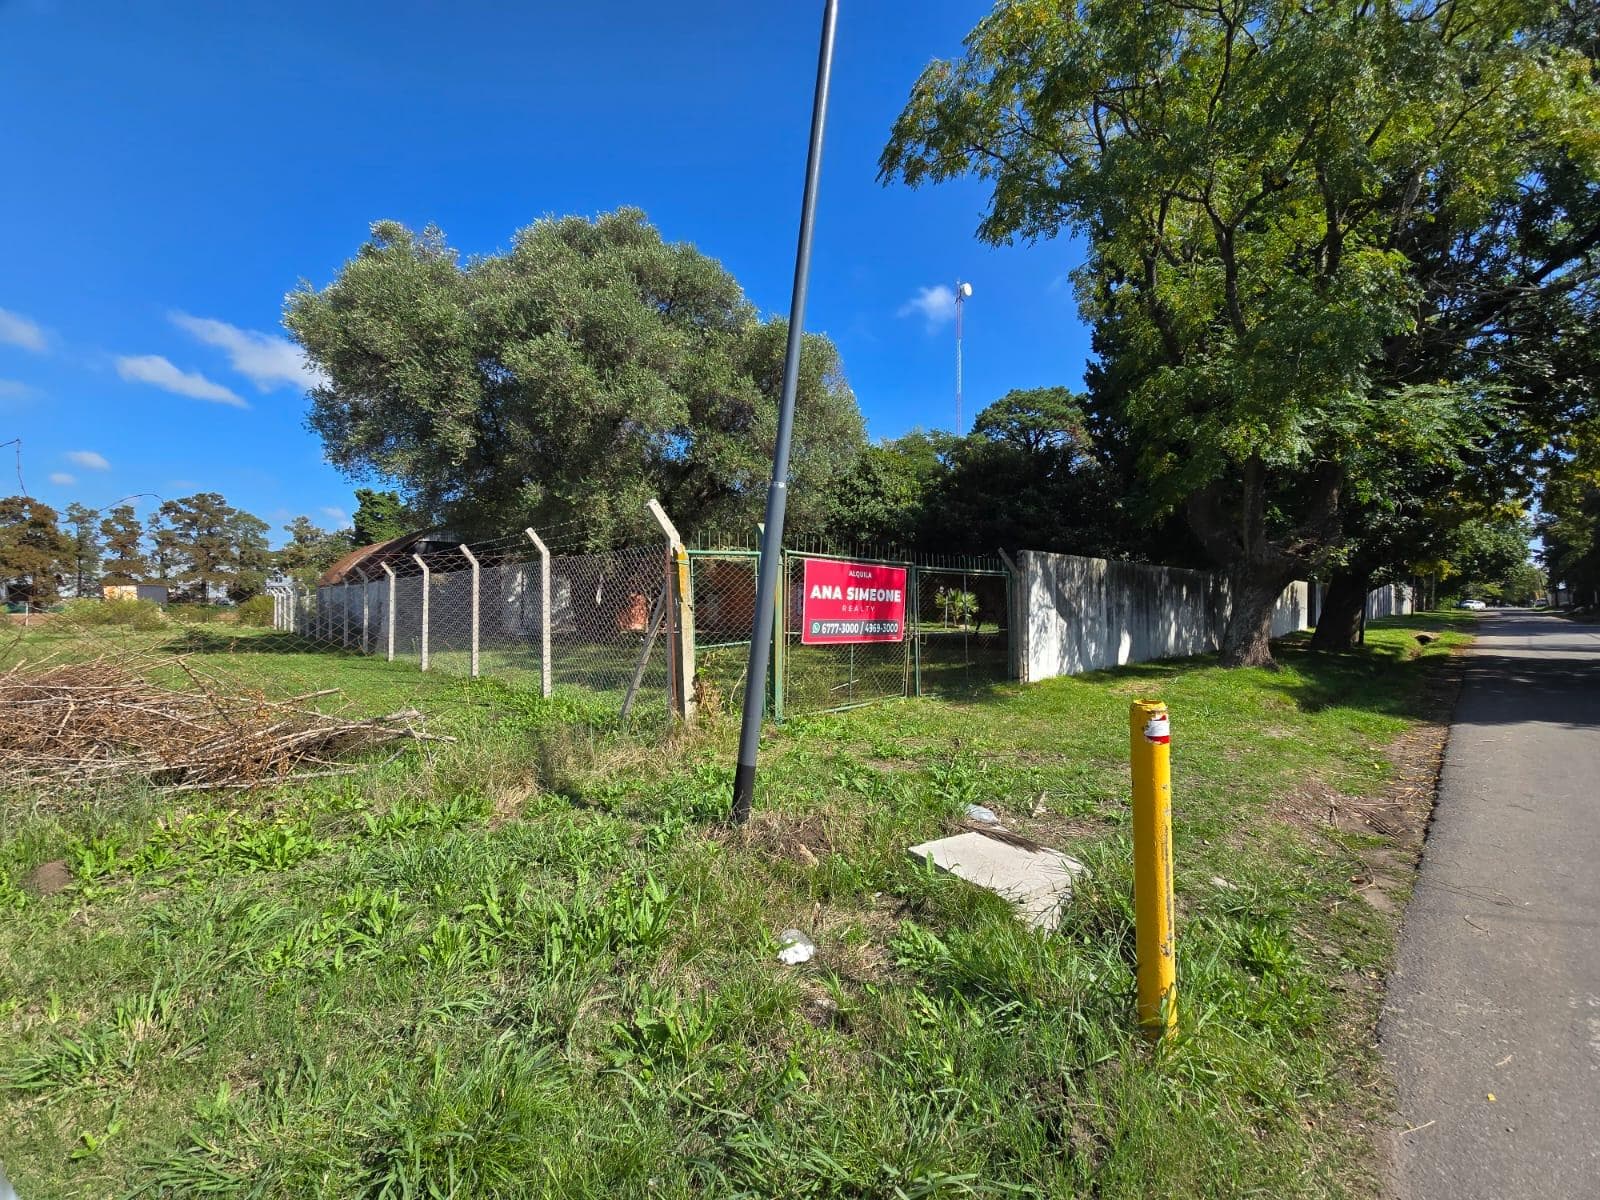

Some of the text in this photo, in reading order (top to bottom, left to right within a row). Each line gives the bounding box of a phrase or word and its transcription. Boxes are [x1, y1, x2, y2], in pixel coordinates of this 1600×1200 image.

[810, 585, 901, 602] ANA SIMEONE
[821, 622, 859, 634] 6777-3000
